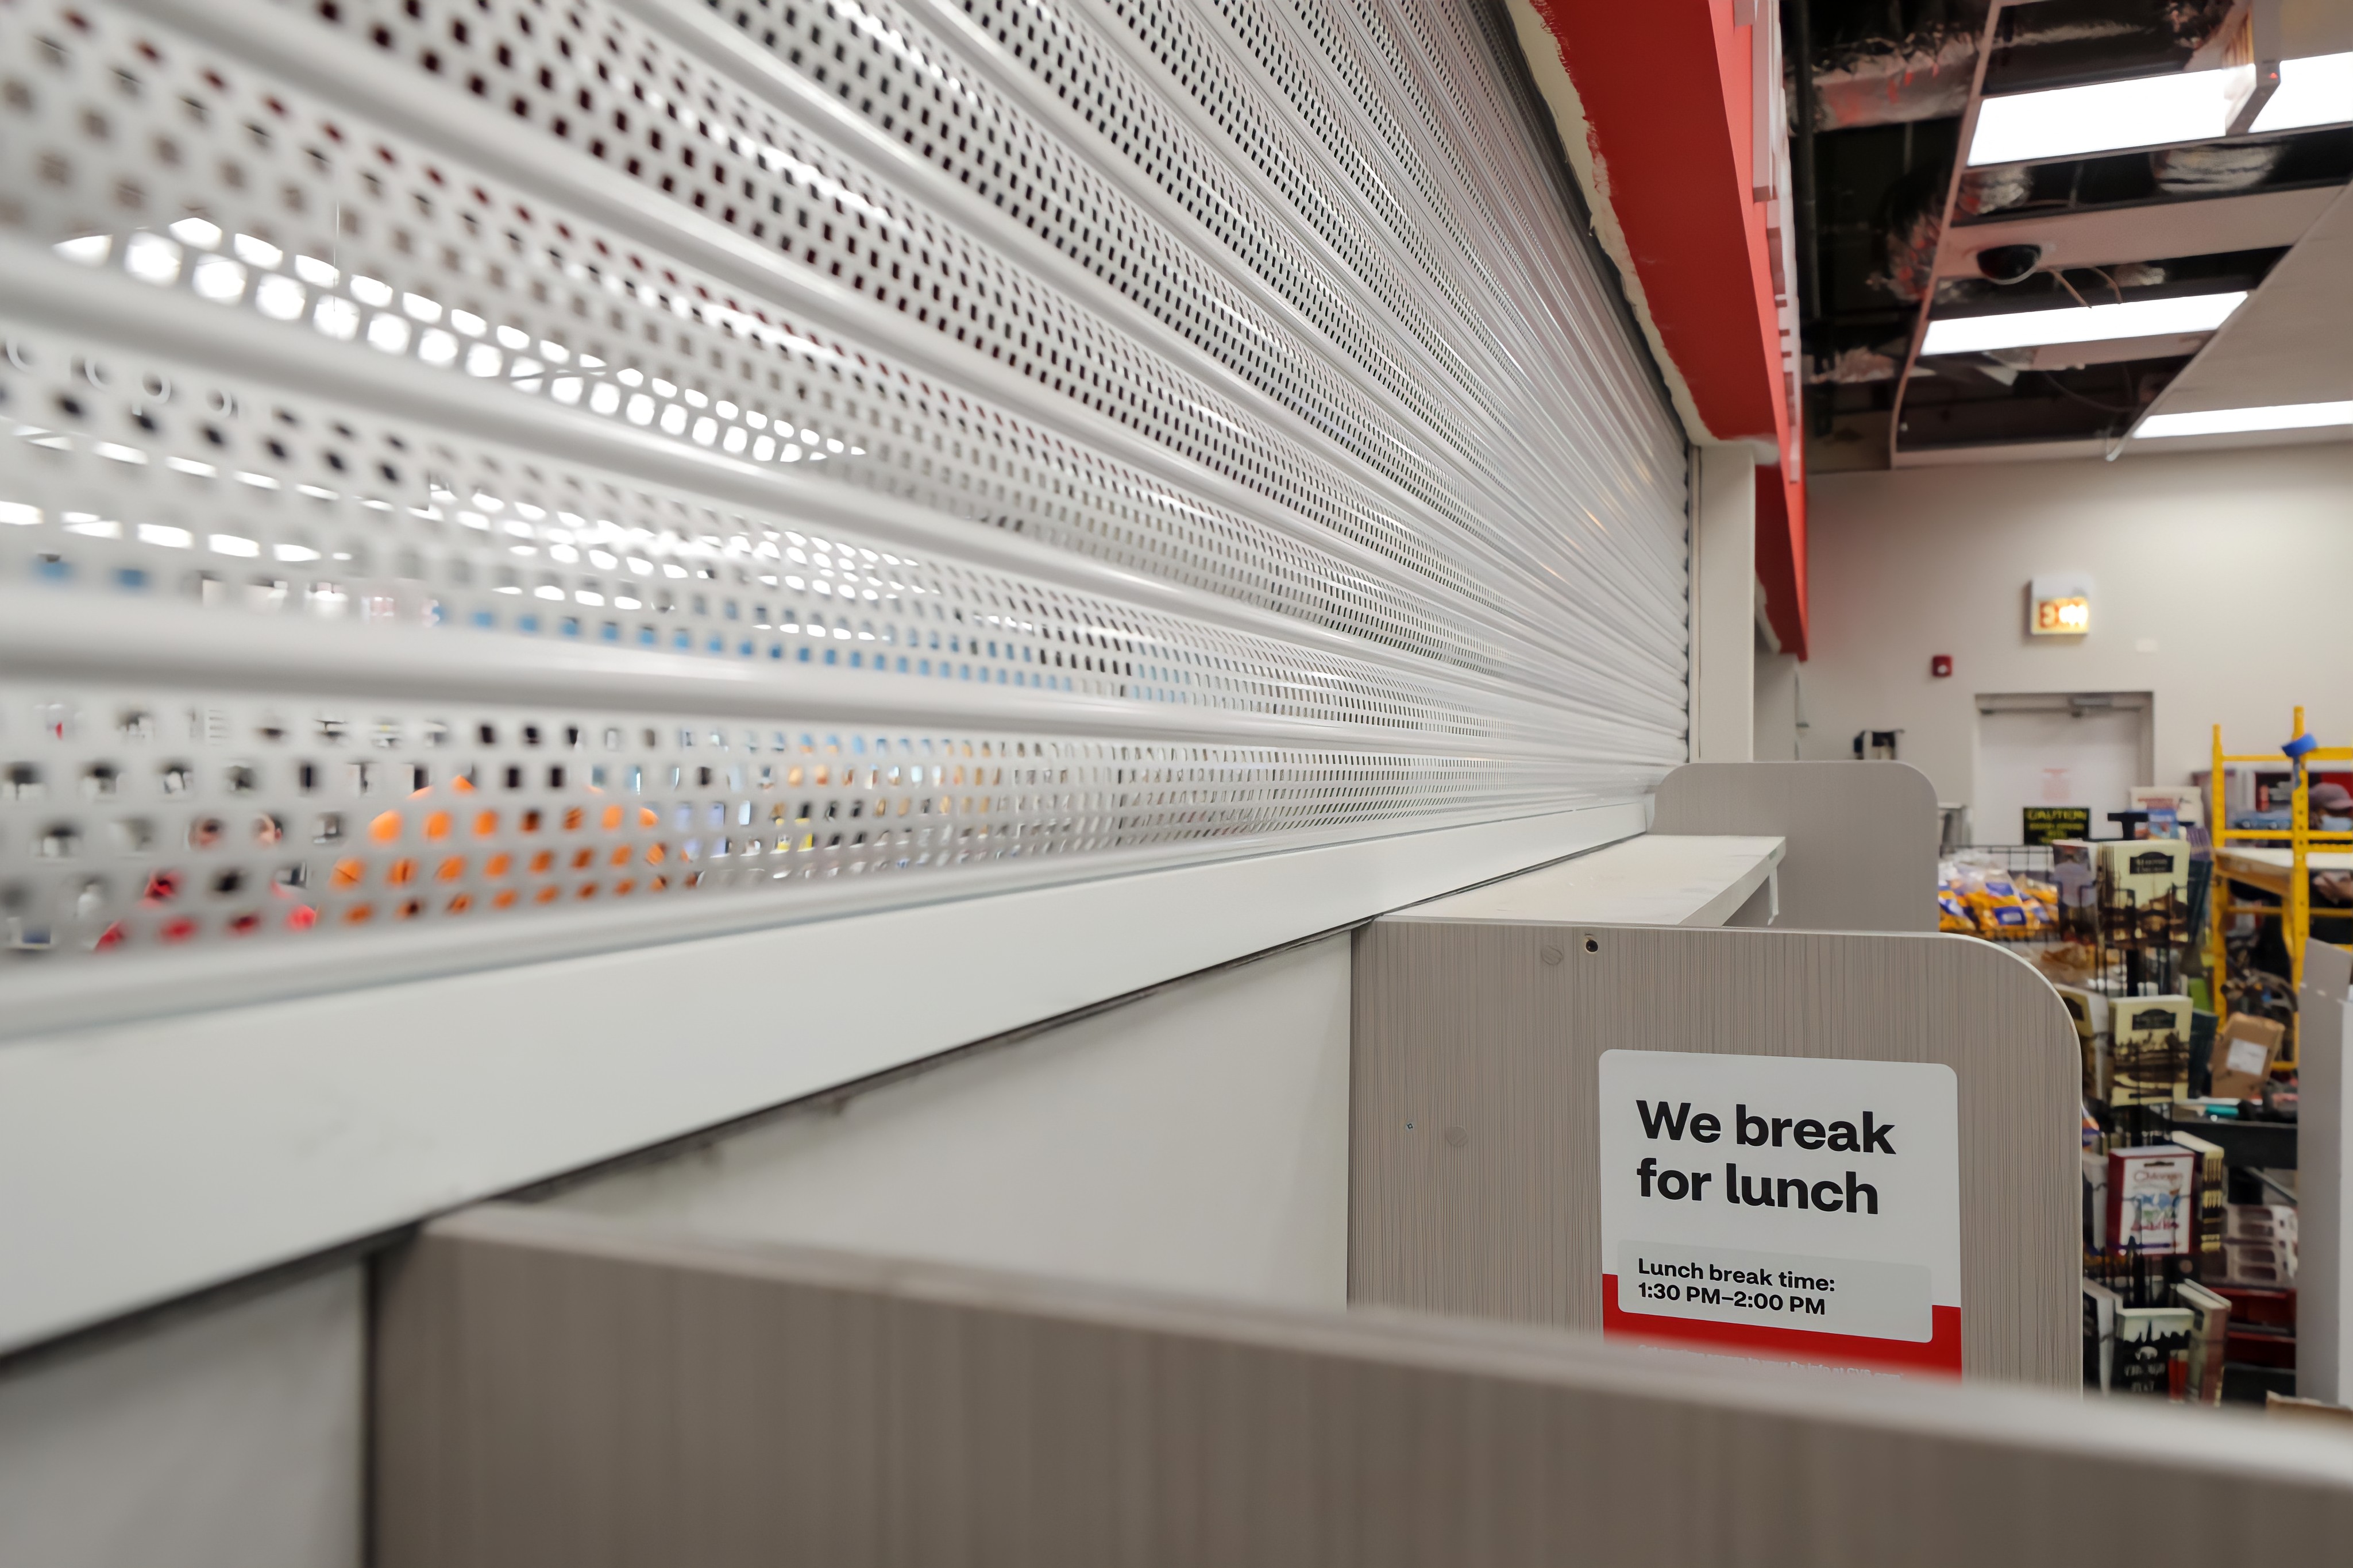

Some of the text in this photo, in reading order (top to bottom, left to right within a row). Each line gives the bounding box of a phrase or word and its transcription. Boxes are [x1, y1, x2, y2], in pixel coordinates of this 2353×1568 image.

[1635, 1099, 1896, 1155] We break
[1636, 1157, 1878, 1215] for lunch
[1638, 1258, 1835, 1292] Lunch break time:
[1638, 1282, 1680, 1301] 1:30
[1789, 1296, 1826, 1315] PM
